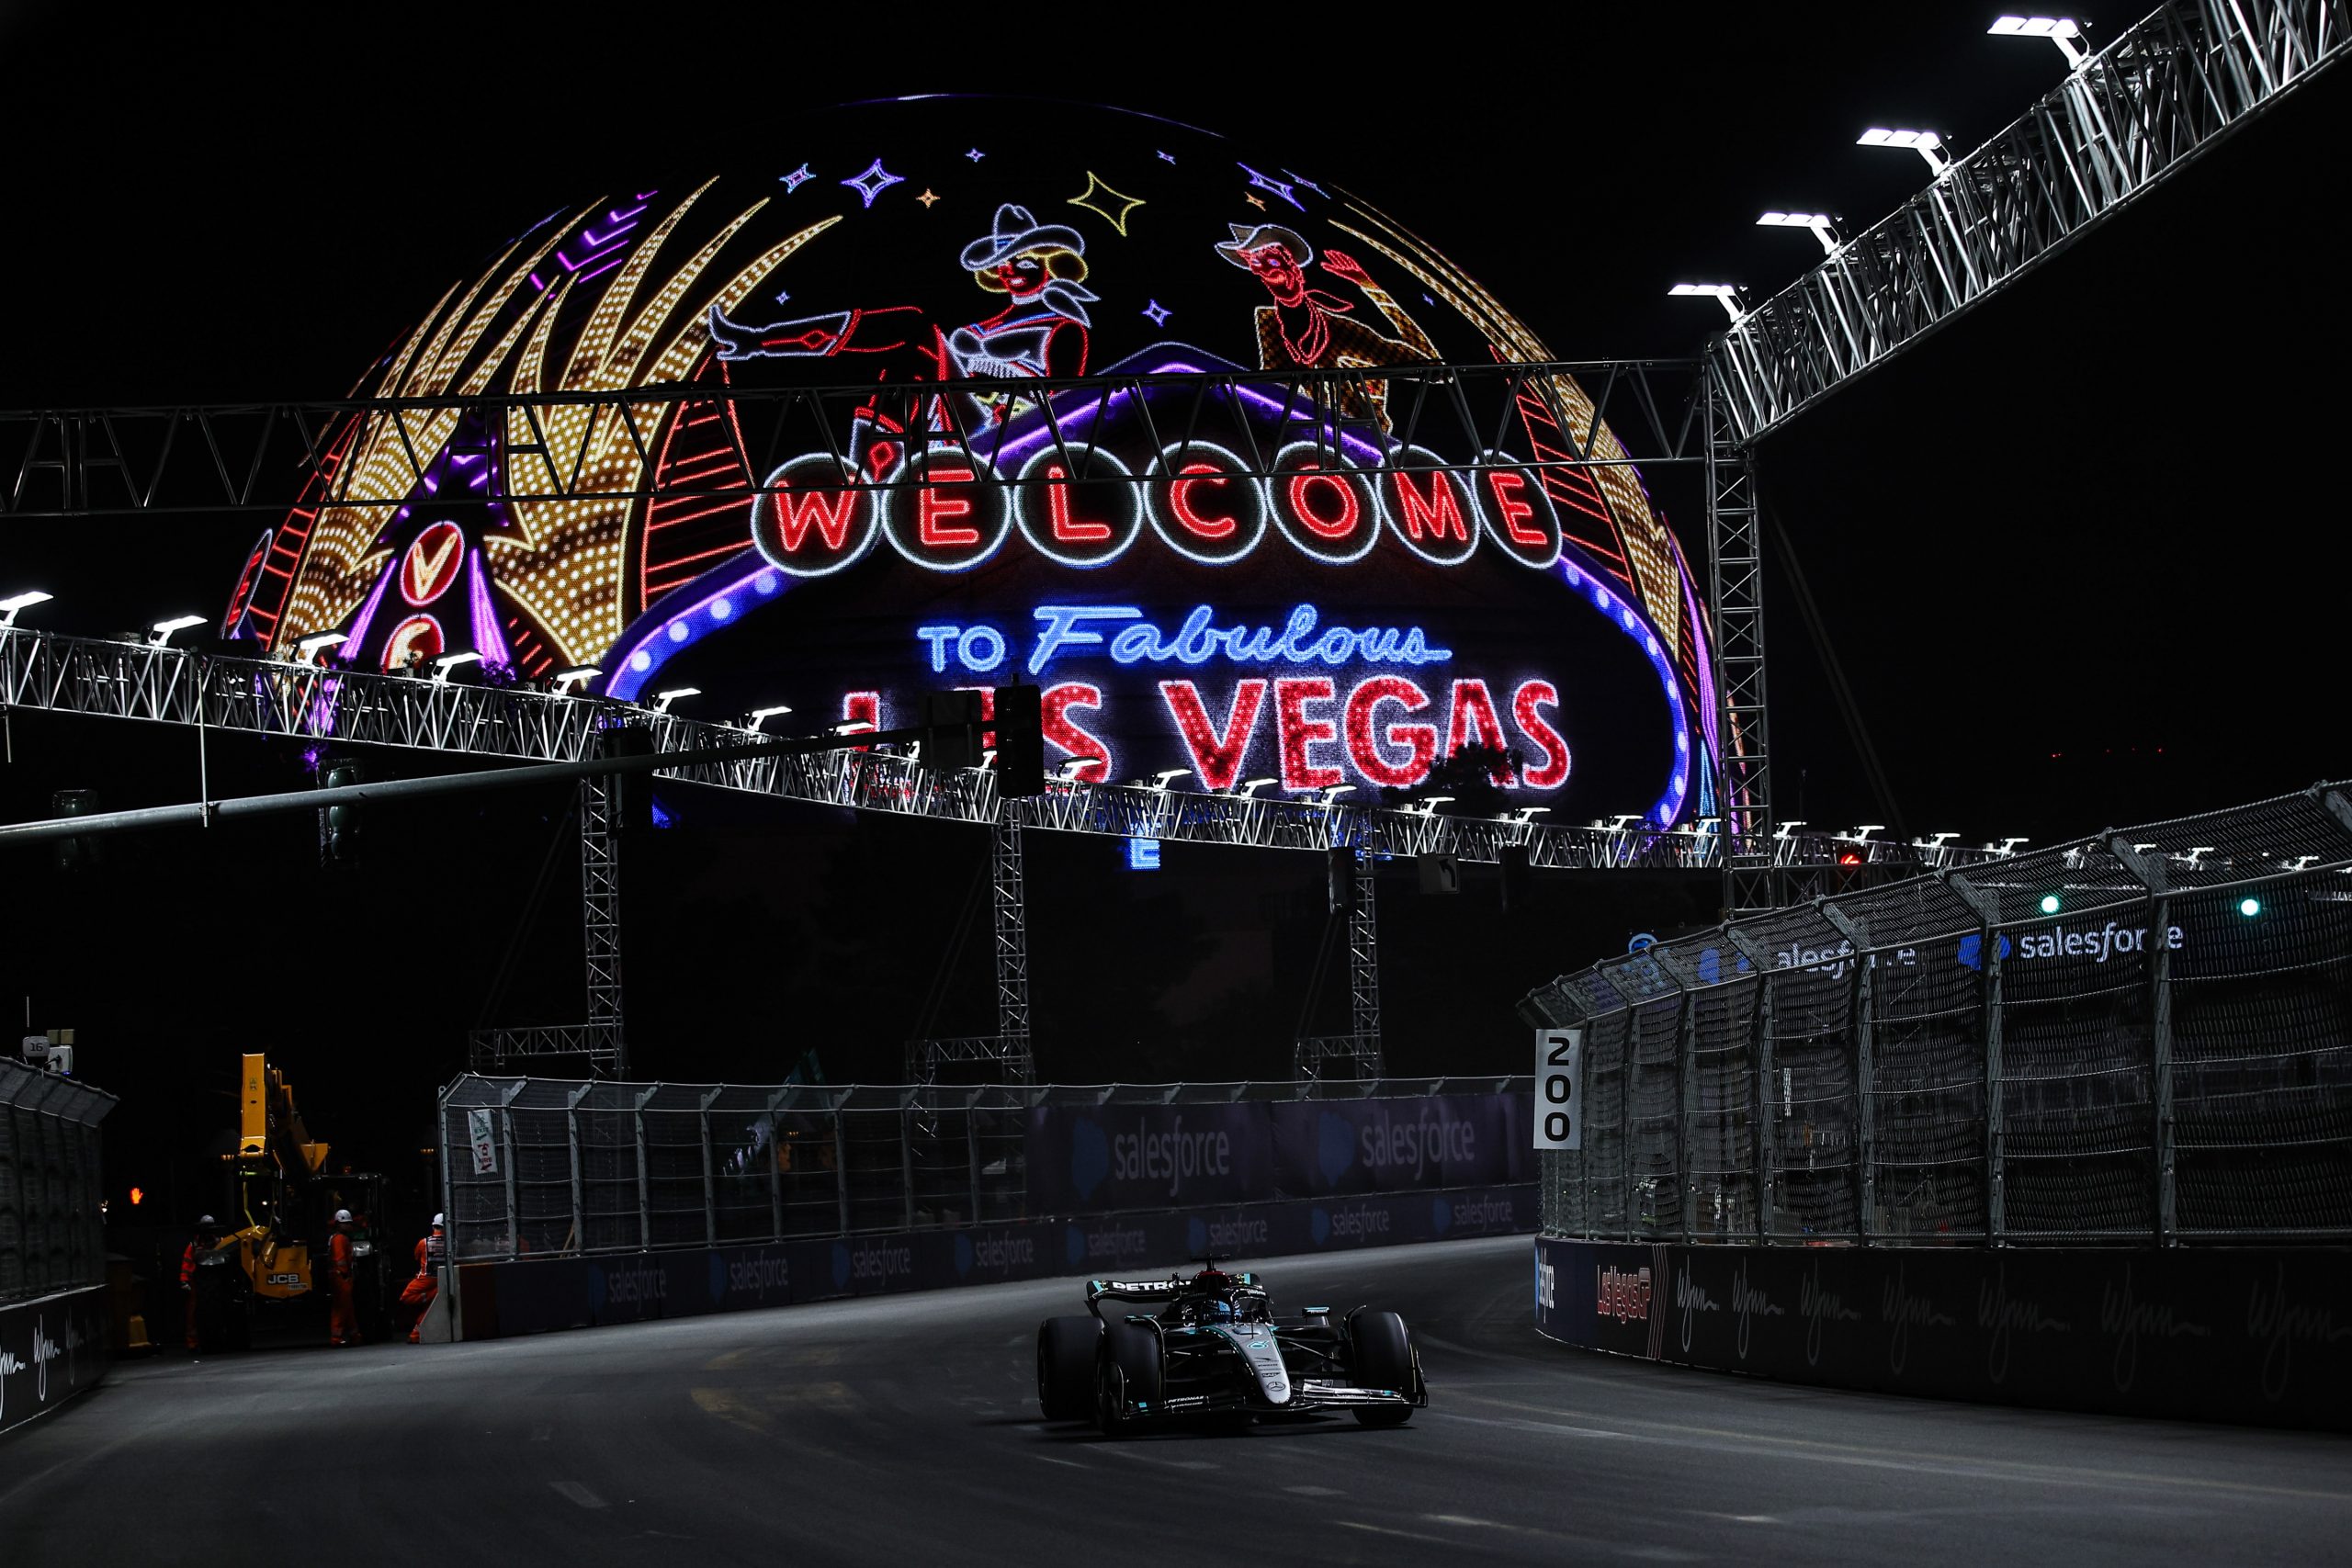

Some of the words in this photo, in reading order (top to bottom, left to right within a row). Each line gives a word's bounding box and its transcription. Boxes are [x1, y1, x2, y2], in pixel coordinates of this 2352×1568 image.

[774, 464, 1547, 549] WELCOME
[917, 626, 1006, 672] TO
[1027, 604, 1453, 675] Fabulous
[1159, 676, 1572, 793] VEGAS
[2020, 922, 2184, 963] salesfore
[30, 1043, 43, 1051] 16
[1544, 1037, 1571, 1142] 200
[1114, 1115, 1230, 1196] salesforce
[1362, 1109, 1476, 1181] salesforce
[1087, 1225, 1146, 1270] salesforce
[1209, 1215, 1268, 1261] salesforce
[1332, 1206, 1389, 1250] salesforce
[1453, 1197, 1513, 1240] salesforce
[267, 1274, 299, 1283] JCB
[608, 1260, 668, 1312] salesforce
[729, 1249, 788, 1299] salesforce
[853, 1239, 911, 1285] salesforce
[976, 1231, 1035, 1280] salesforce
[1677, 1254, 1720, 1352] Wynn
[1732, 1257, 1785, 1359] Wynn
[1800, 1257, 1861, 1366] Wynn
[1883, 1259, 1955, 1375] Wynn
[1978, 1260, 2072, 1384] Wynn
[2101, 1259, 2211, 1393] Wynn
[34, 1314, 62, 1402] Wynn
